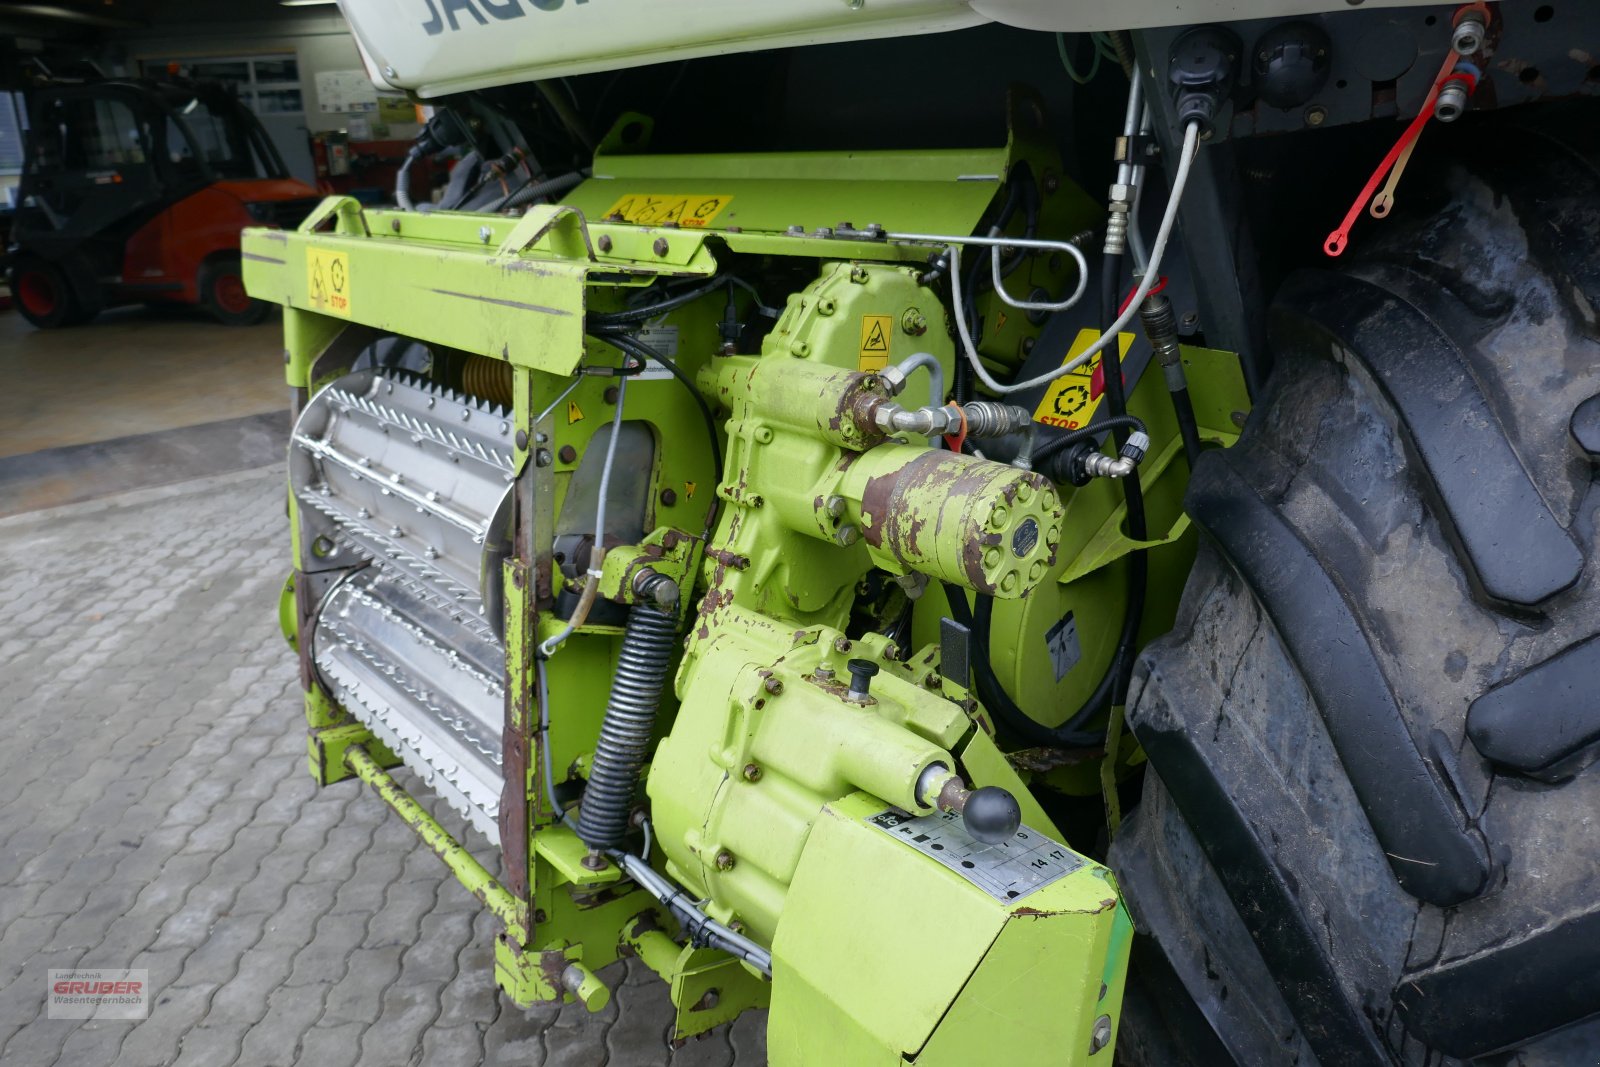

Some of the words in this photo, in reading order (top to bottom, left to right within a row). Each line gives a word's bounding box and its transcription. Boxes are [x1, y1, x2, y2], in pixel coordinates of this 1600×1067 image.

[331, 295, 347, 309] STOP
[1040, 416, 1079, 429] STOP
[1031, 859, 1049, 869] 14
[1050, 850, 1065, 860] 17
